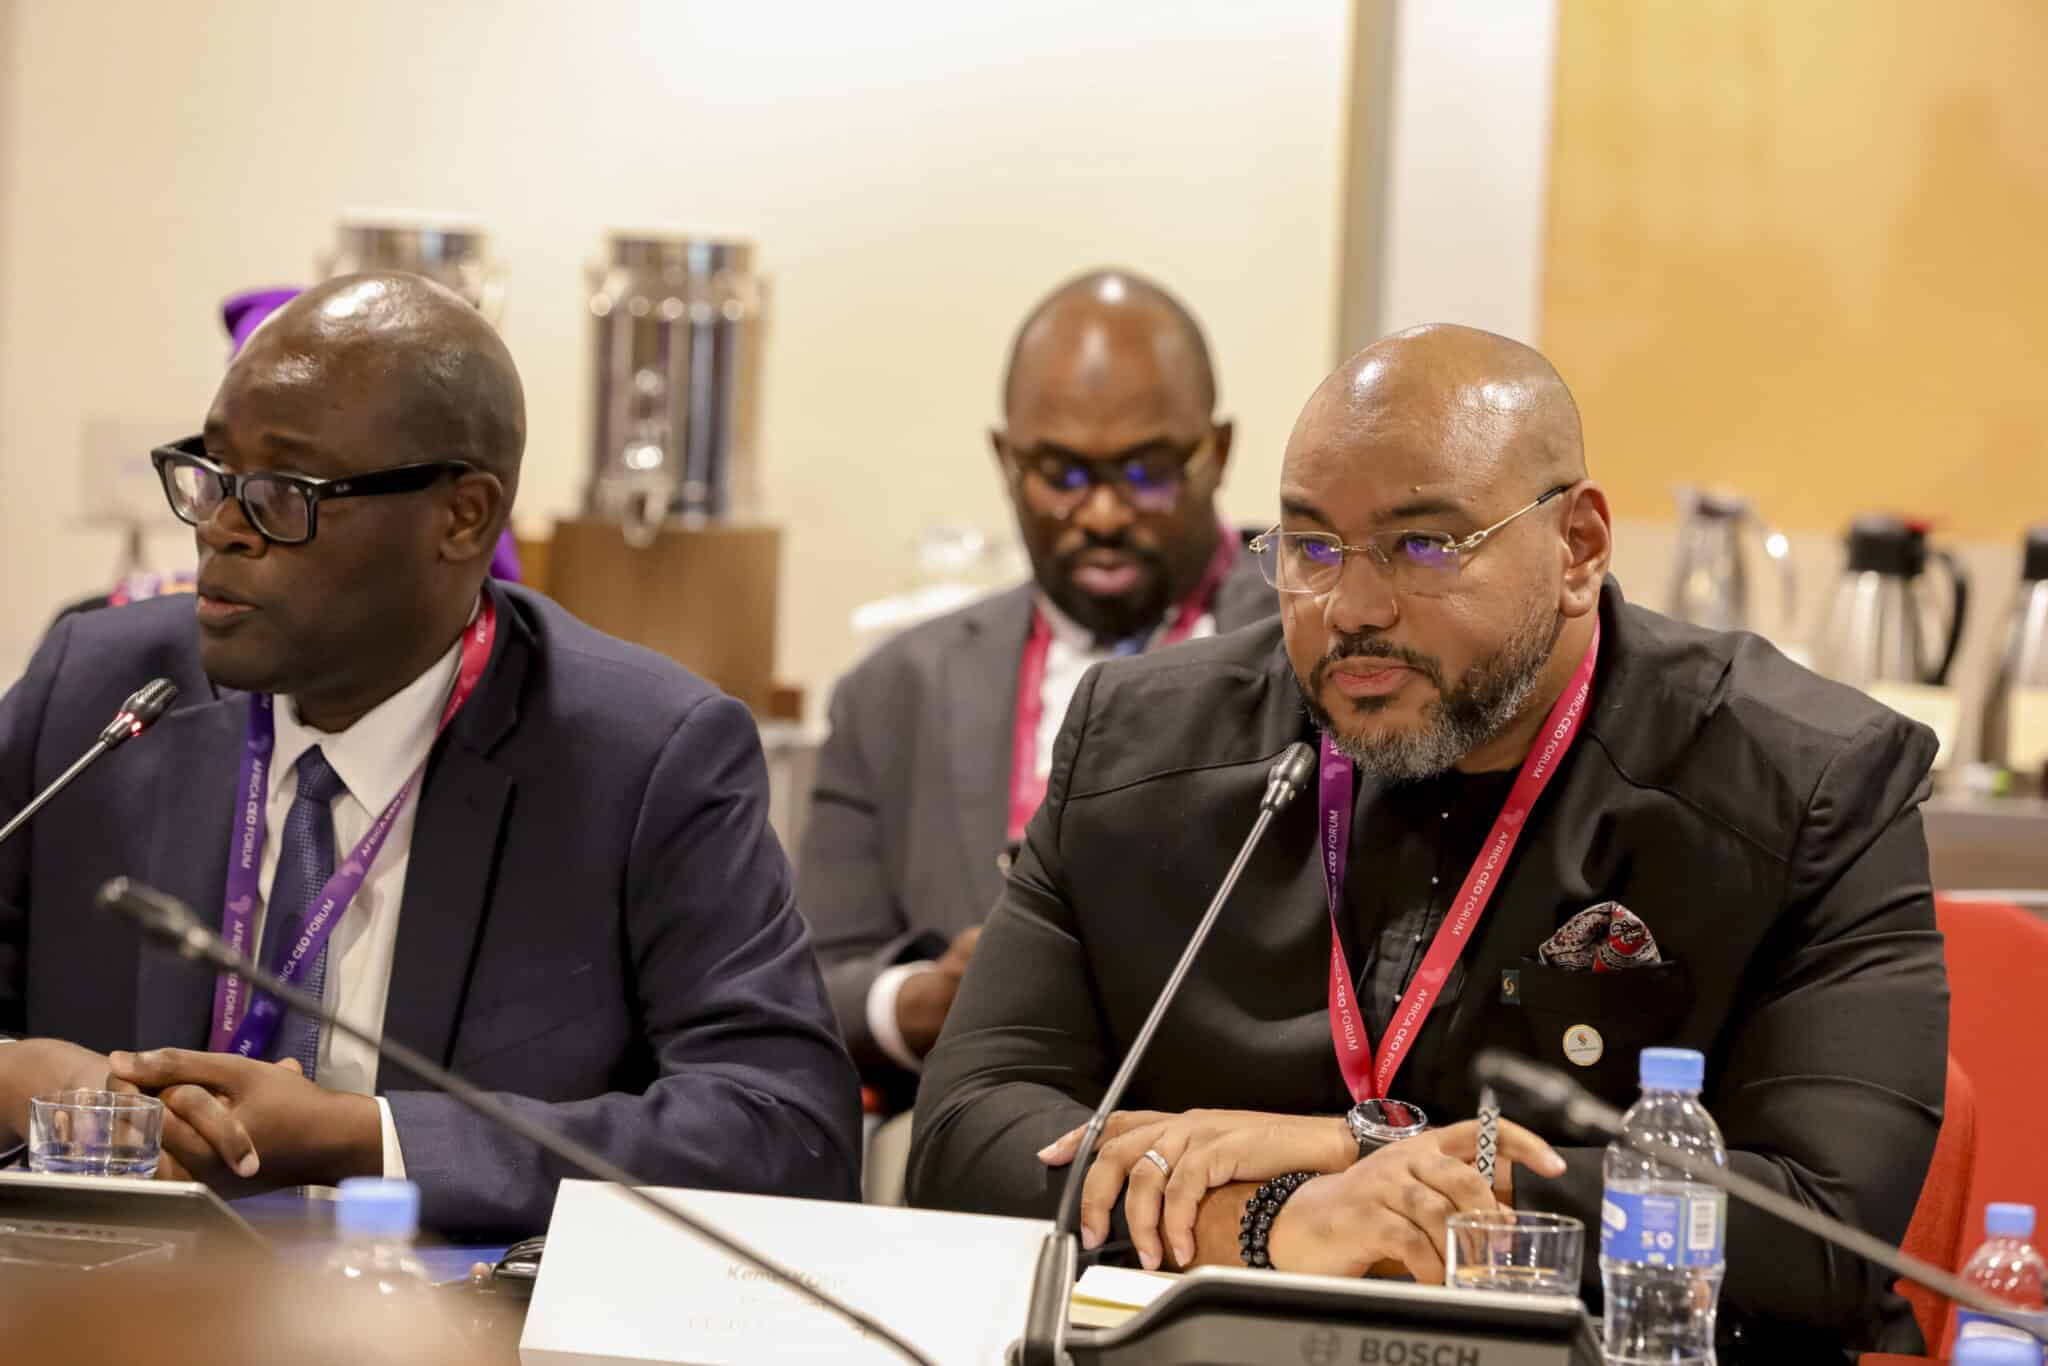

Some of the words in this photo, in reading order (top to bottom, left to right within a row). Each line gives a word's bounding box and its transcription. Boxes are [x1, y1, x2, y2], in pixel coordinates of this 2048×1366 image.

[1567, 681, 1590, 717] AFRICA
[1553, 716, 1572, 739] CEO
[249, 758, 264, 800] AFRICA
[1532, 739, 1559, 779] FORUM
[245, 801, 258, 825] CEO
[1327, 808, 1340, 850] FORUM
[240, 826, 256, 870] FORUM
[1328, 850, 1338, 874] CEO
[1484, 831, 1509, 871] AFRICA
[1472, 871, 1490, 896] CEO
[291, 936, 311, 959] CEO
[304, 898, 335, 937] FORUM
[1451, 895, 1479, 936] FORUM
[223, 988, 238, 1032] FORUM
[1336, 984, 1346, 1007] CEO
[1341, 1009, 1359, 1050] FORUM
[1402, 988, 1428, 1027] AFRICA
[1390, 1027, 1409, 1051] CEO
[1360, 1338, 1479, 1366] BOSCH
